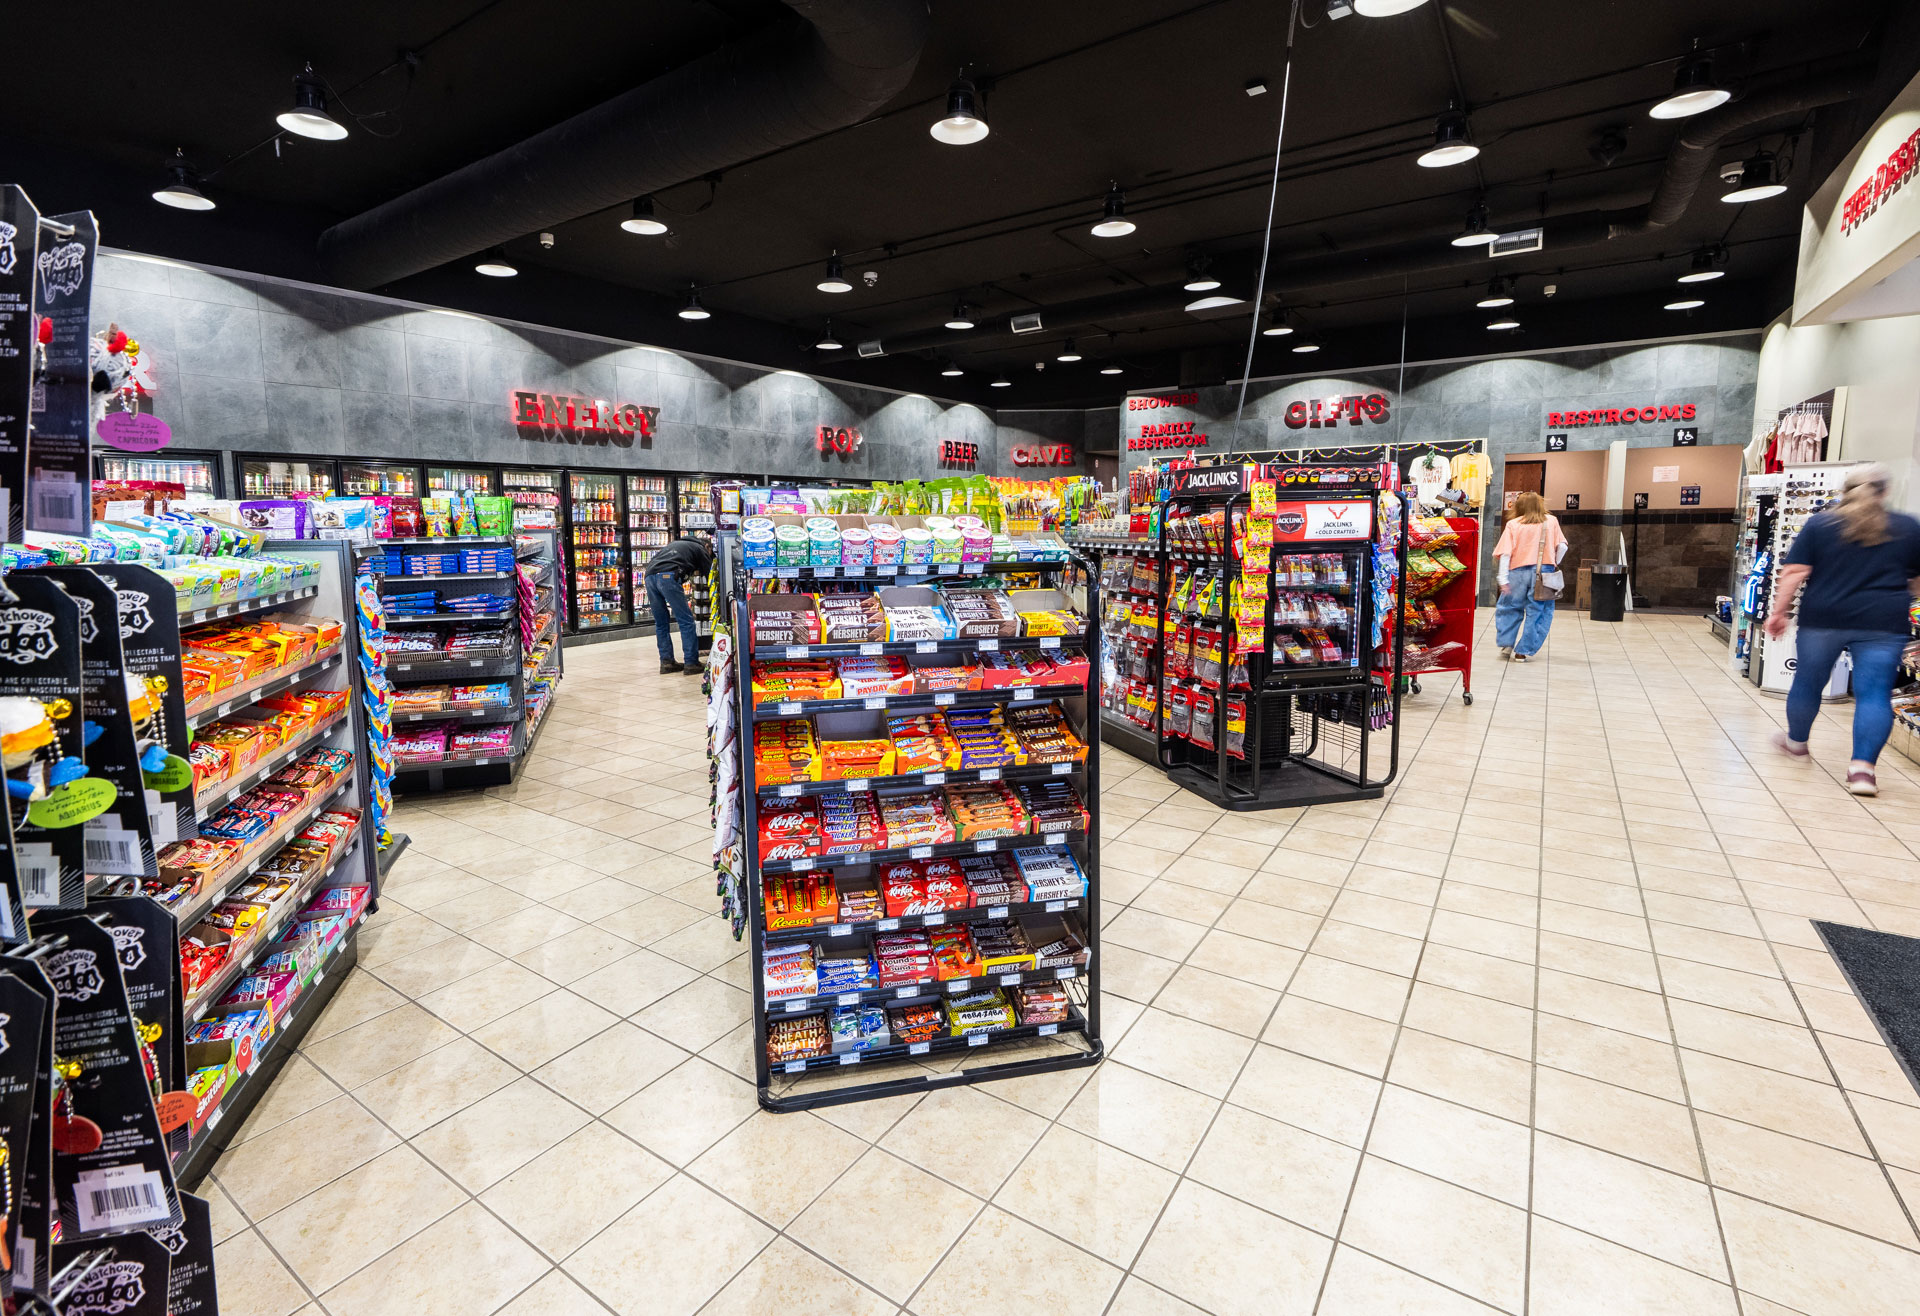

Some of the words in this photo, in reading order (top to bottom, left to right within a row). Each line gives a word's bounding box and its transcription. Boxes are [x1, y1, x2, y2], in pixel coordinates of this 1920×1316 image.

[1128, 393, 1199, 410] SHOWERS
[514, 391, 660, 434] ENERGY
[1286, 393, 1385, 422] GIFTS
[1548, 403, 1696, 426] RESTROOMS
[1141, 421, 1193, 436] FAMILY
[117, 436, 159, 445] CAPRICORN
[819, 426, 863, 450] POP
[1128, 434, 1207, 449] RESTROOM
[944, 440, 979, 460] BEER
[1012, 444, 1074, 464] CAVE
[1187, 472, 1209, 488] JACK
[823, 599, 861, 608] HERSHEY'S
[828, 615, 868, 625] HERSHEY'S
[833, 628, 869, 639] HERSHEY'S
[896, 629, 927, 639] HERSHEY'S
[966, 624, 999, 635] HERSHEY'S
[756, 630, 794, 641] HERSHEY'S
[452, 638, 501, 646] Twizzlers
[20, 677, 69, 685] COLLECTABLE
[929, 678, 959, 689] PAYDAY
[63, 686, 80, 694] THAT
[455, 690, 500, 700] Twizzlers
[857, 684, 888, 695] PAYDAY
[1014, 707, 1050, 716] HEATH
[955, 728, 990, 736] Caramello
[1023, 727, 1058, 737] HEATH
[455, 735, 504, 745] Twizzlers
[960, 737, 995, 745] Caramello
[1032, 739, 1067, 750] HEATH
[389, 741, 440, 752] Twizzlers
[1042, 754, 1074, 764] HEATH
[965, 761, 1001, 770] Caramello
[56, 799, 87, 810] February
[58, 800, 103, 821] AQUARIUS
[825, 824, 857, 832] SNICKERS
[1040, 821, 1072, 831] HERSHEY'S
[828, 845, 861, 854] SNICKERS
[1018, 846, 1051, 857] HERSHEY'S
[173, 851, 195, 867] TWIX
[959, 855, 993, 867] HERSHEY'S
[1023, 860, 1059, 872] HERSHEY'S
[967, 869, 1001, 880] HERSHEY'S
[973, 882, 1009, 894] HERSHEY'S
[977, 894, 1011, 906] HERSHEY'S
[1035, 889, 1069, 900] HERSHEY'S
[770, 916, 813, 929] Reese's
[879, 944, 914, 954] Mounds
[51, 951, 95, 971] Watchover
[884, 957, 916, 967] Mounds
[1041, 956, 1074, 968] HERSHEY'S
[767, 962, 801, 976] PAYDAY
[987, 963, 1020, 974] HERSHEY'S
[820, 983, 847, 993] Almond
[884, 979, 916, 988] Mounds
[767, 985, 805, 998] PAYDAY
[906, 1010, 938, 1024] SKOR
[962, 1009, 1004, 1020] ABBA-ZABA
[909, 1023, 942, 1034] SKOR
[779, 1029, 818, 1043] HEATH
[904, 1034, 933, 1043] SKOR
[776, 1037, 817, 1054] HEATH
[780, 1050, 819, 1061] HEATH
[160, 1113, 178, 1125] CES
[82, 1262, 144, 1284] Watchover
[170, 1271, 193, 1283] ASCOTS
[194, 1265, 209, 1275] THAT
